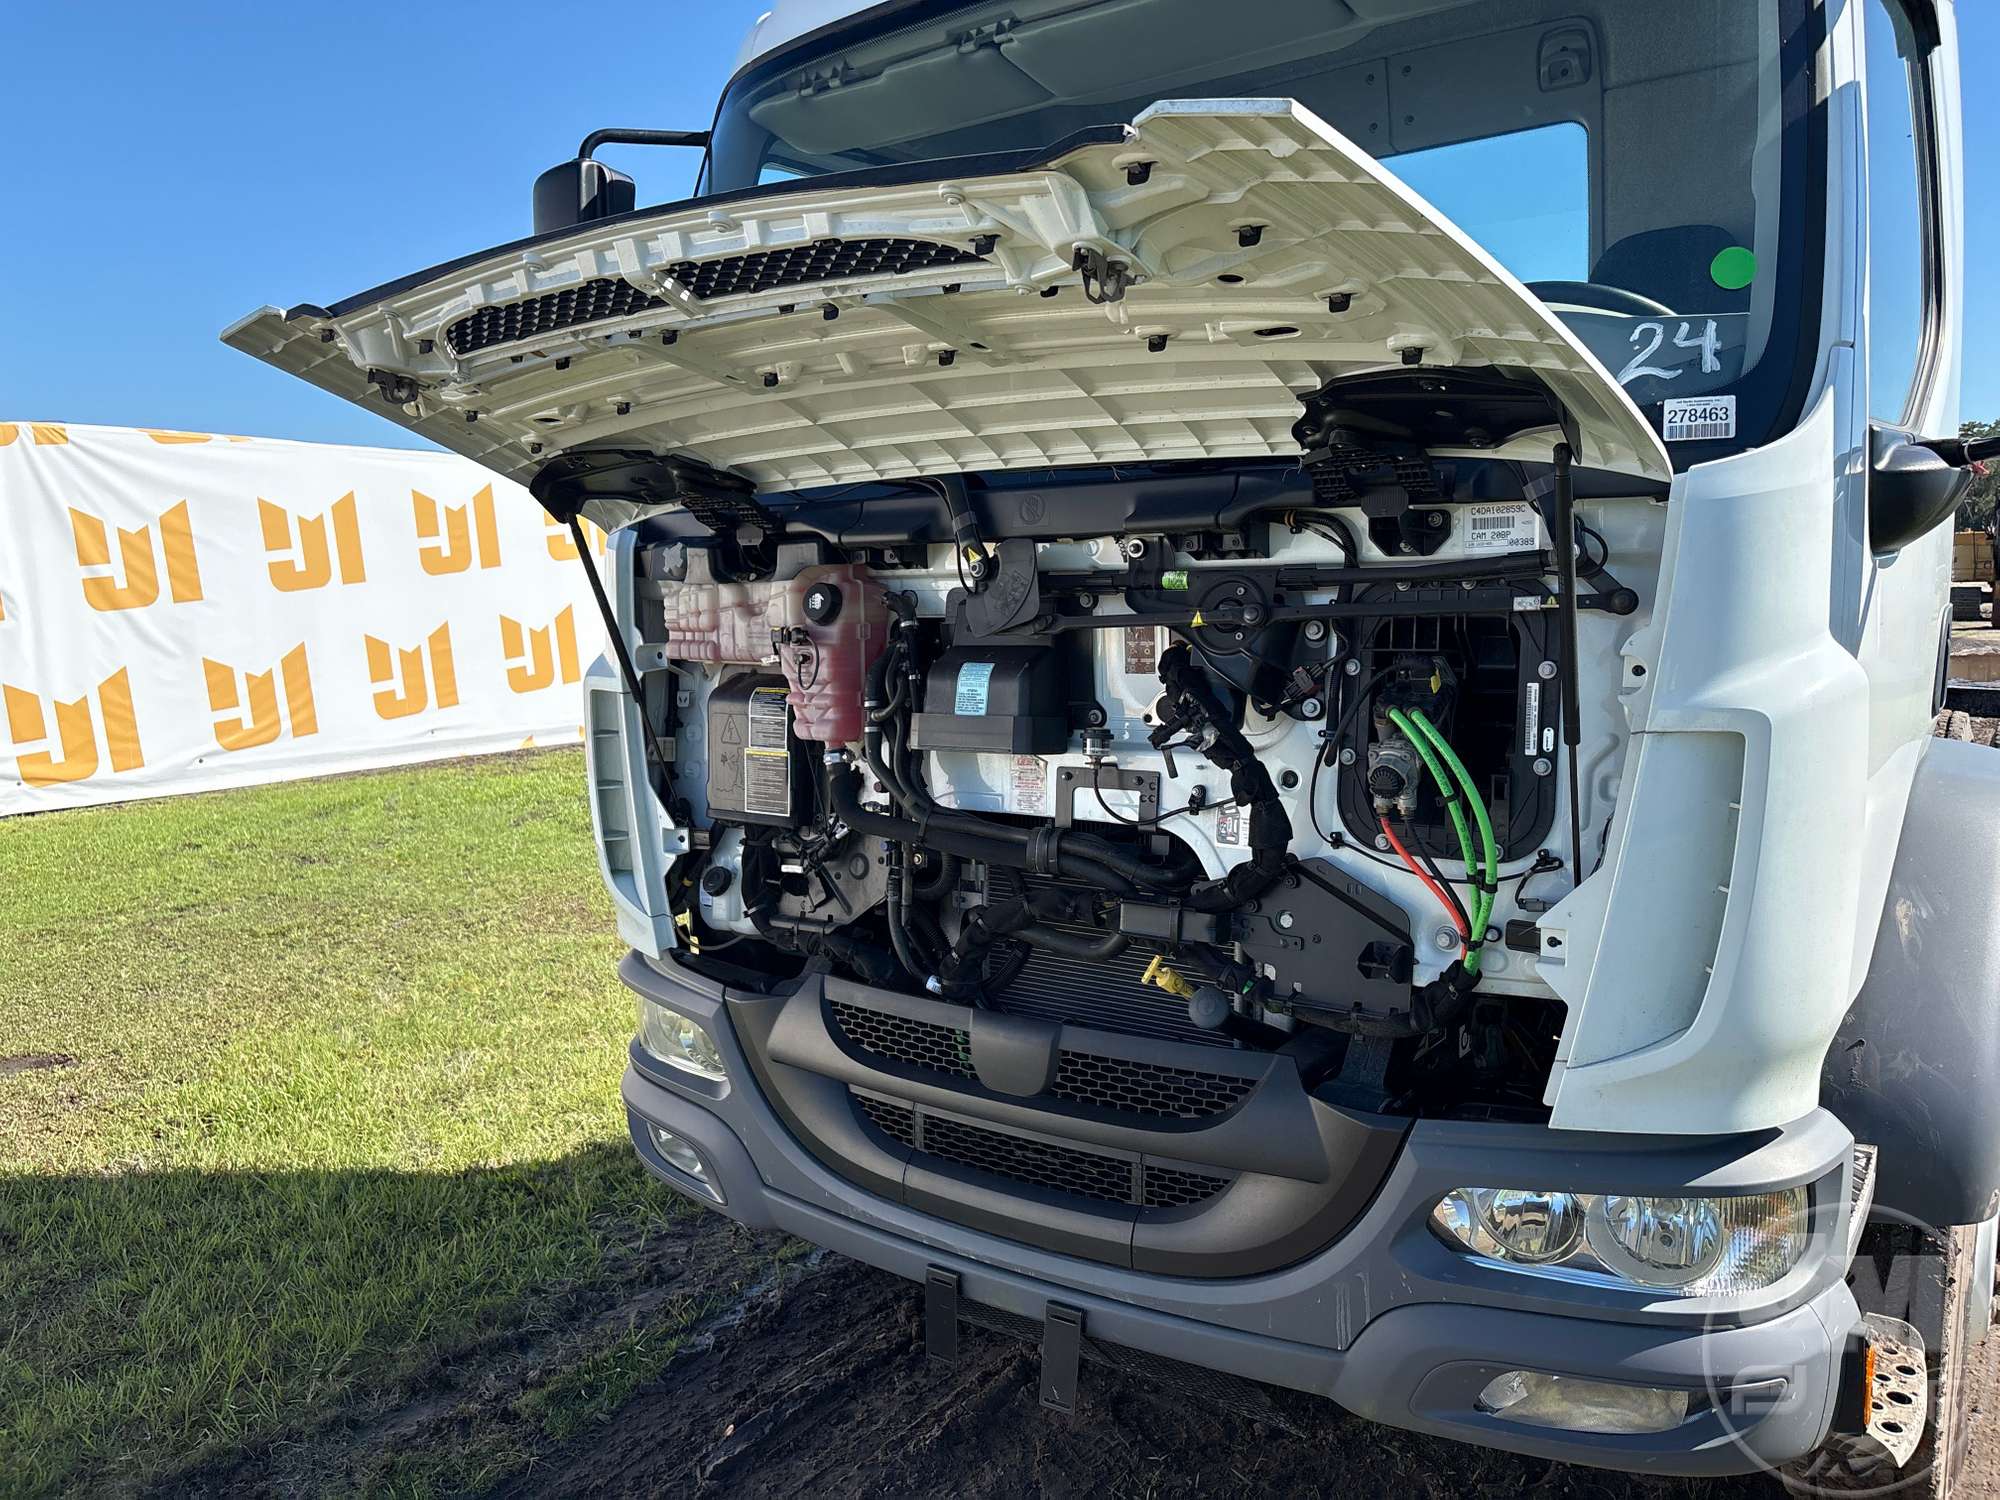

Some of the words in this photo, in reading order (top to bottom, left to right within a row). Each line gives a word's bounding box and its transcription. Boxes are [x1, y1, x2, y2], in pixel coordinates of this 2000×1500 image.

[1616, 318, 1722, 386] 24
[1667, 406, 1729, 424] 278463
[1471, 532, 1487, 540] CAM
